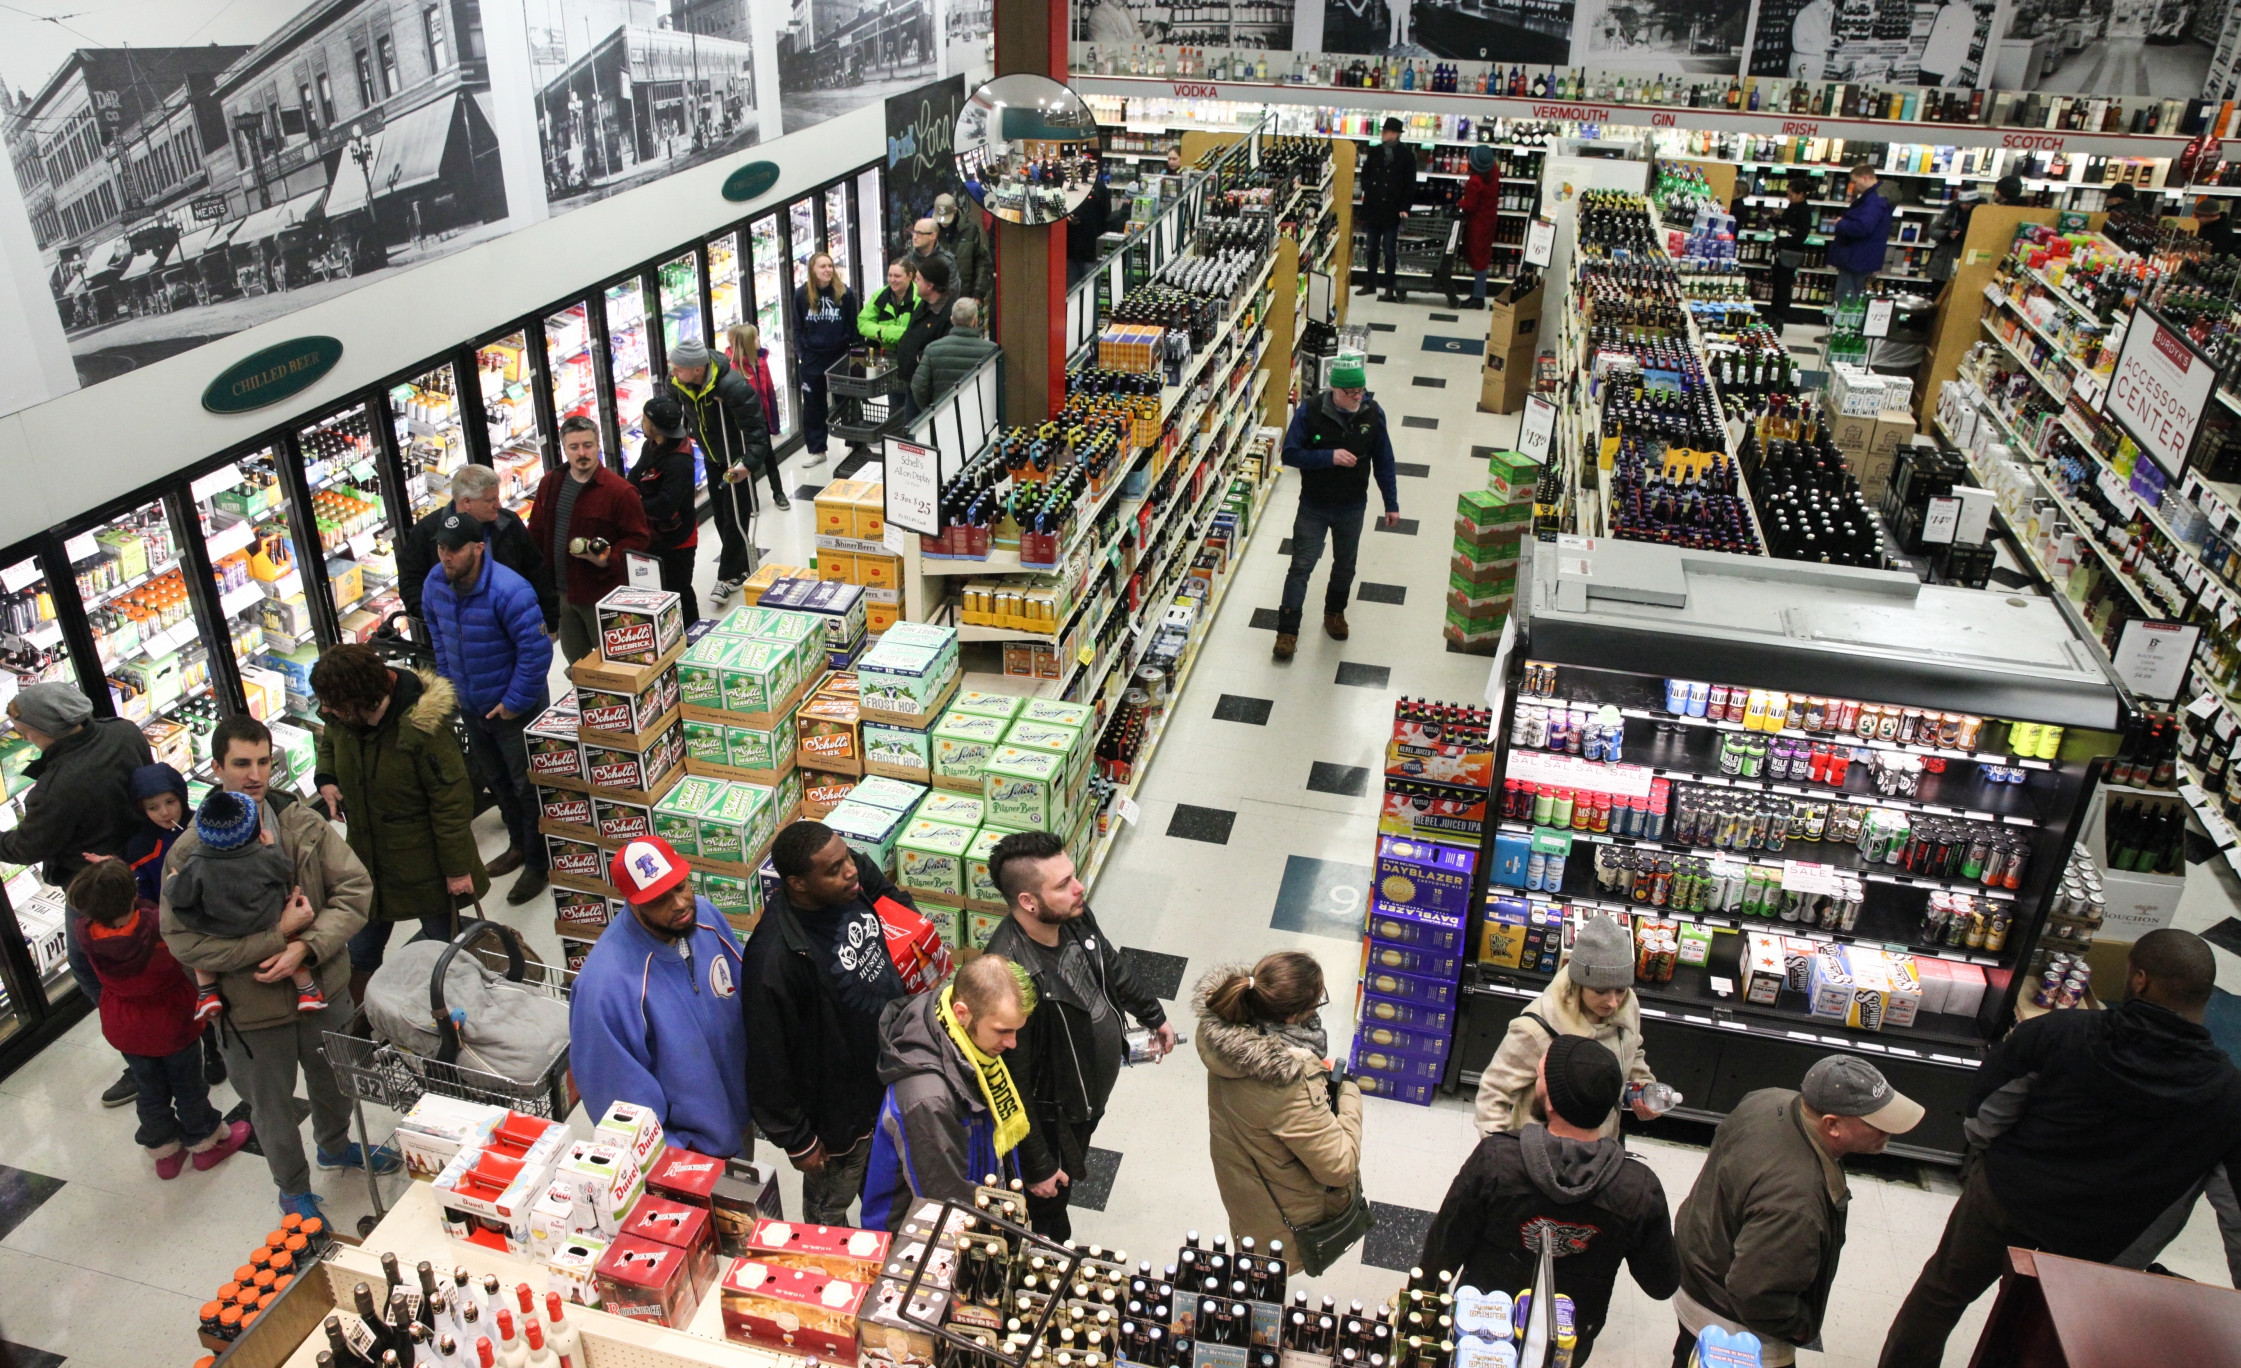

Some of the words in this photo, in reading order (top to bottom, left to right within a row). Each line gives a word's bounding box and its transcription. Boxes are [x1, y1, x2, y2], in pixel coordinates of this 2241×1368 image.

[1173, 85, 1218, 98] VODKA
[1532, 105, 1609, 122] VERMOUTH
[1651, 113, 1675, 127] GIN
[1781, 121, 1818, 136] IRISH
[912, 95, 956, 182] Local
[2001, 134, 2064, 151] SCOTCH
[195, 206, 226, 219] MEATS
[2155, 331, 2190, 367] SURDYK'S
[231, 364, 287, 396] CHILLED
[288, 351, 320, 374] BEER
[1848, 386, 1866, 395] HOUSE
[1866, 387, 1885, 395] HOUSE
[1894, 383, 1913, 391] HOUSE
[2125, 355, 2195, 430] ACCESSORY
[1842, 407, 1860, 415] WINE
[1862, 408, 1879, 416] WINE
[1890, 404, 1906, 412] WINE
[2117, 376, 2185, 459] CENTER
[901, 455, 924, 470] Schell's
[894, 467, 903, 476] All
[903, 471, 911, 479] on
[912, 472, 931, 486] Display
[894, 492, 899, 500] 2
[913, 497, 931, 515] $25
[4, 560, 34, 578] SALE
[606, 625, 652, 646] Schell's
[610, 639, 652, 653] FIREBRICK
[900, 657, 919, 665] HOP
[866, 696, 896, 711] FROST
[898, 702, 918, 713] HOP
[585, 706, 630, 727] Schell's
[805, 733, 848, 751] Schell's
[1399, 745, 1414, 754] REBEL
[1414, 748, 1431, 756] JUICED
[533, 752, 576, 769] Schell's
[870, 753, 904, 767] FROST
[906, 757, 923, 768] HOP
[593, 762, 638, 782] Schell's
[942, 765, 965, 776] Pilsner
[1610, 768, 1647, 781] SALE
[600, 776, 640, 787] FIREBRICK
[867, 781, 883, 789] HOP
[884, 783, 915, 796] FROST
[547, 802, 587, 818] Schell's
[842, 805, 857, 814] HOP
[859, 808, 891, 822] FROST
[993, 802, 1018, 813] Pilsner
[1019, 804, 1040, 815] Beer
[604, 819, 644, 834] Schell's
[1415, 816, 1439, 827] REBEL
[1440, 818, 1466, 831] JUICED
[1468, 821, 1481, 832] IPA
[557, 855, 596, 869] Schell's
[1382, 863, 1463, 885] DAYBLAZER
[1789, 865, 1827, 878] SALE
[907, 877, 933, 888] Pilsner
[934, 878, 953, 888] Beer
[1329, 885, 1361, 915] 9
[562, 905, 603, 920] Schell's
[1379, 904, 1459, 924] DAYBLAZER
[2100, 911, 2161, 924] BOUCHON
[918, 917, 928, 926] 12
[838, 912, 880, 971] GOD
[1683, 945, 1704, 953] RESIN
[858, 941, 877, 967] BLESS
[859, 946, 883, 980] HUSTLE
[867, 958, 887, 983] GANG
[616, 1105, 639, 1118] Duvel
[637, 1118, 662, 1158] Duvel
[592, 1148, 616, 1159] Duvel
[663, 1161, 715, 1178] RODENBACH
[614, 1161, 640, 1201] Duvel
[462, 1196, 485, 1210] Duvel
[550, 1221, 565, 1230] Duvel
[562, 1252, 586, 1265] Duvel
[606, 1301, 663, 1318] RODENBACH
[956, 1314, 996, 1328] Kwak
[1209, 1349, 1245, 1360] Bernardus
